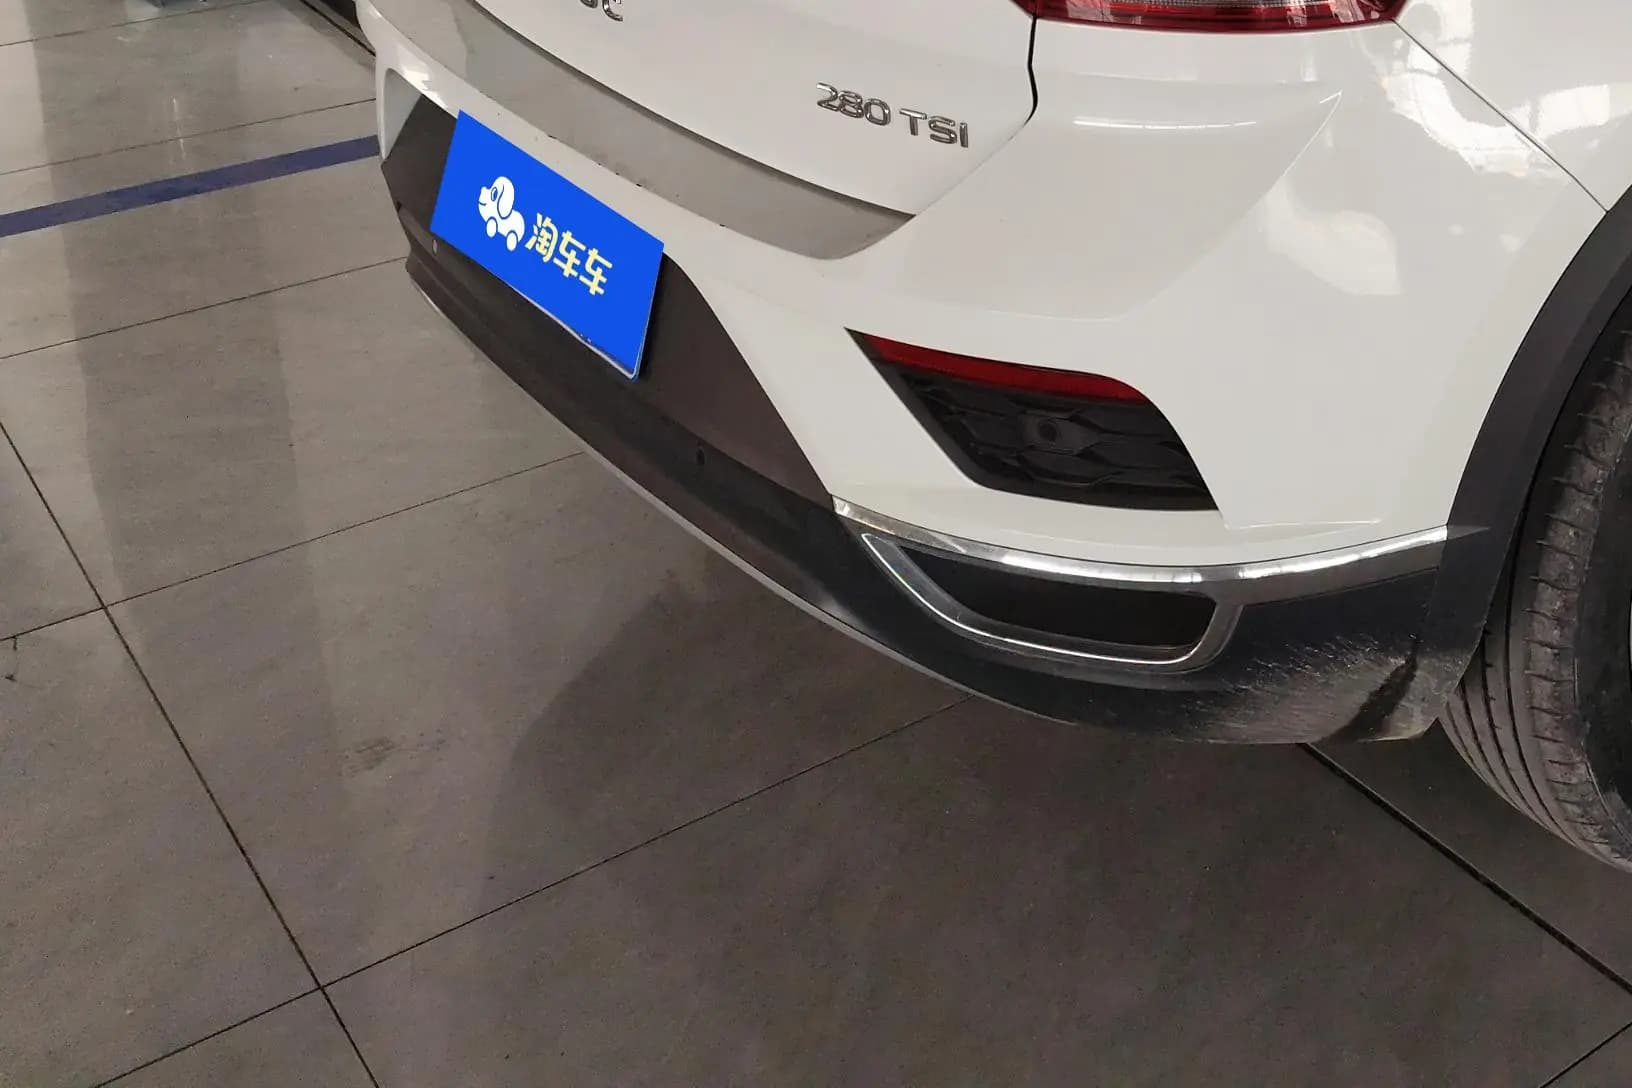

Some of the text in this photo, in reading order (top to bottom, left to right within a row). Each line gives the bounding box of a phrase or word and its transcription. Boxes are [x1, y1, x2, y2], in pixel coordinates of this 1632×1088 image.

[816, 82, 969, 149] 280 TSI
[524, 211, 614, 296] 淘车车
